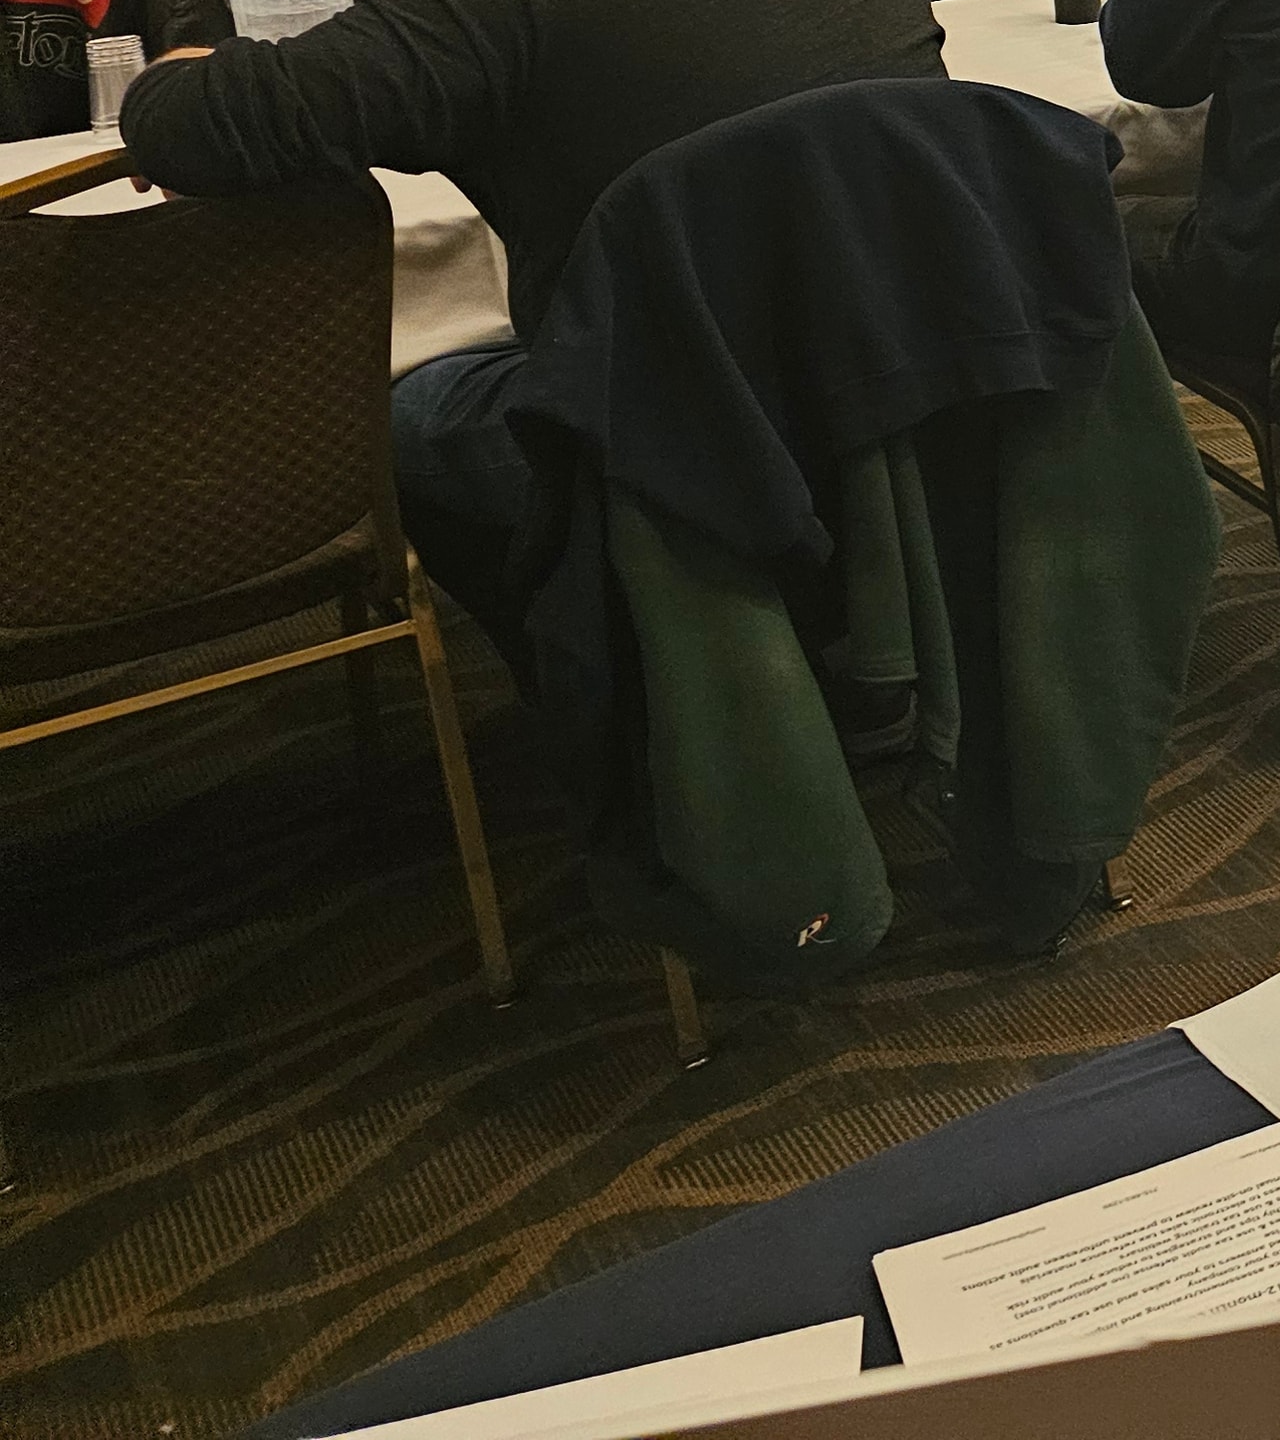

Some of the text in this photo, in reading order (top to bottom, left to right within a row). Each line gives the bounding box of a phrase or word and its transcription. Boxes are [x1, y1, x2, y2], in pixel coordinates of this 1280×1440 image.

[1215, 1186, 1253, 1203] on-site
[1174, 1200, 1213, 1218] review
[1192, 1199, 1246, 1223] electronic
[1159, 1216, 1173, 1224] to
[1159, 1220, 1188, 1234] sales
[1113, 1219, 1158, 1241] prevent
[1138, 1232, 1157, 1242] tax
[1235, 1227, 1255, 1238] use
[1214, 1235, 1233, 1245] tax
[1043, 1238, 1110, 1265] unforeseen
[1080, 1239, 1136, 1263] reference
[1181, 1243, 1211, 1258] audit
[1217, 1244, 1265, 1265] answers
[1009, 1262, 1040, 1277] audit
[1019, 1261, 1077, 1283] materials
[1132, 1255, 1179, 1275] defense
[1110, 1273, 1130, 1283] (no
[1174, 1266, 1200, 1282] your
[961, 1273, 1005, 1291] actions
[1141, 1279, 1171, 1293] sales
[1047, 1281, 1107, 1309] additional
[1116, 1290, 1138, 1304] and
[1013, 1305, 1044, 1319] cost)
[1092, 1300, 1113, 1312] use
[1070, 1310, 1090, 1320] tax
[1006, 1318, 1067, 1344] questions
[989, 1341, 1003, 1350] as
